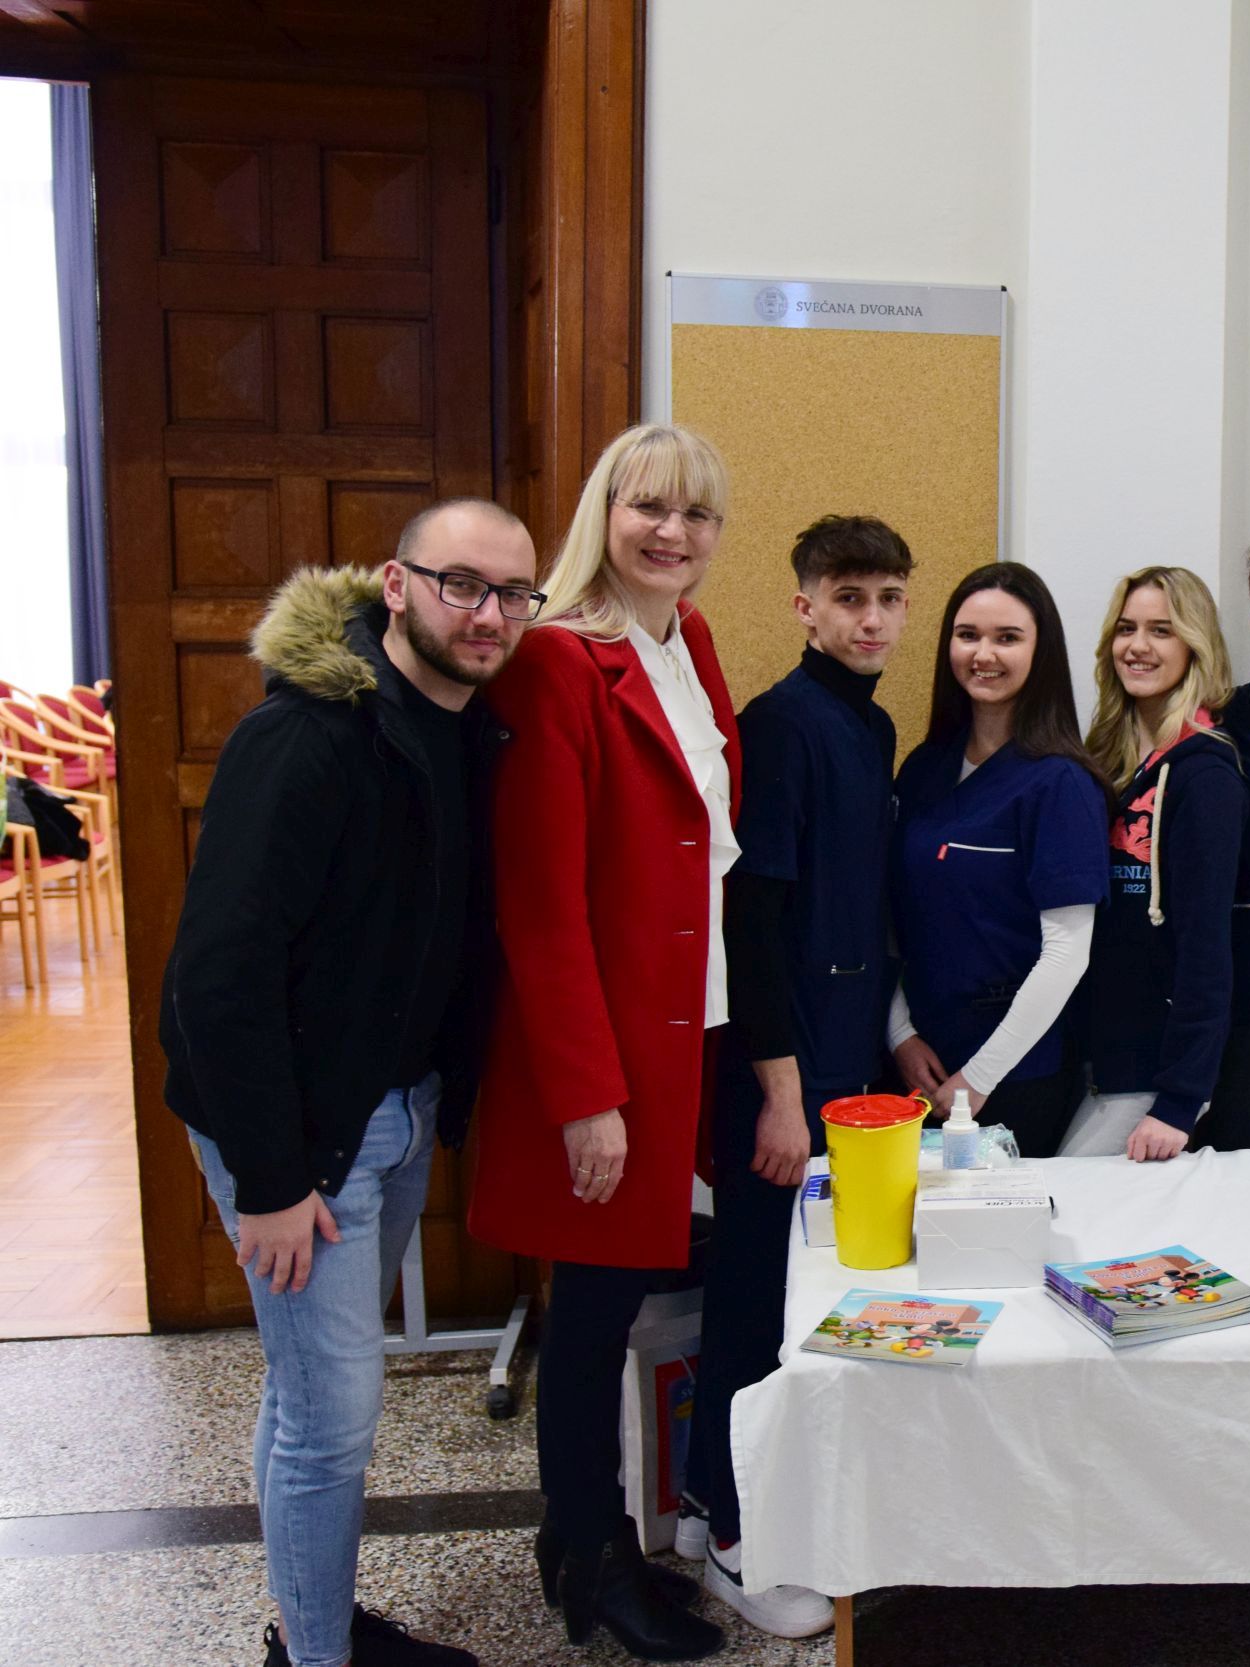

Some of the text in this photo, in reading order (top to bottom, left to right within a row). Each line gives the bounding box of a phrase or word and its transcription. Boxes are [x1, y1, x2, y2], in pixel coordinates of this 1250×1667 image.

[796, 299, 923, 317] SVEČANA DVORANA
[1123, 883, 1147, 894] 1922
